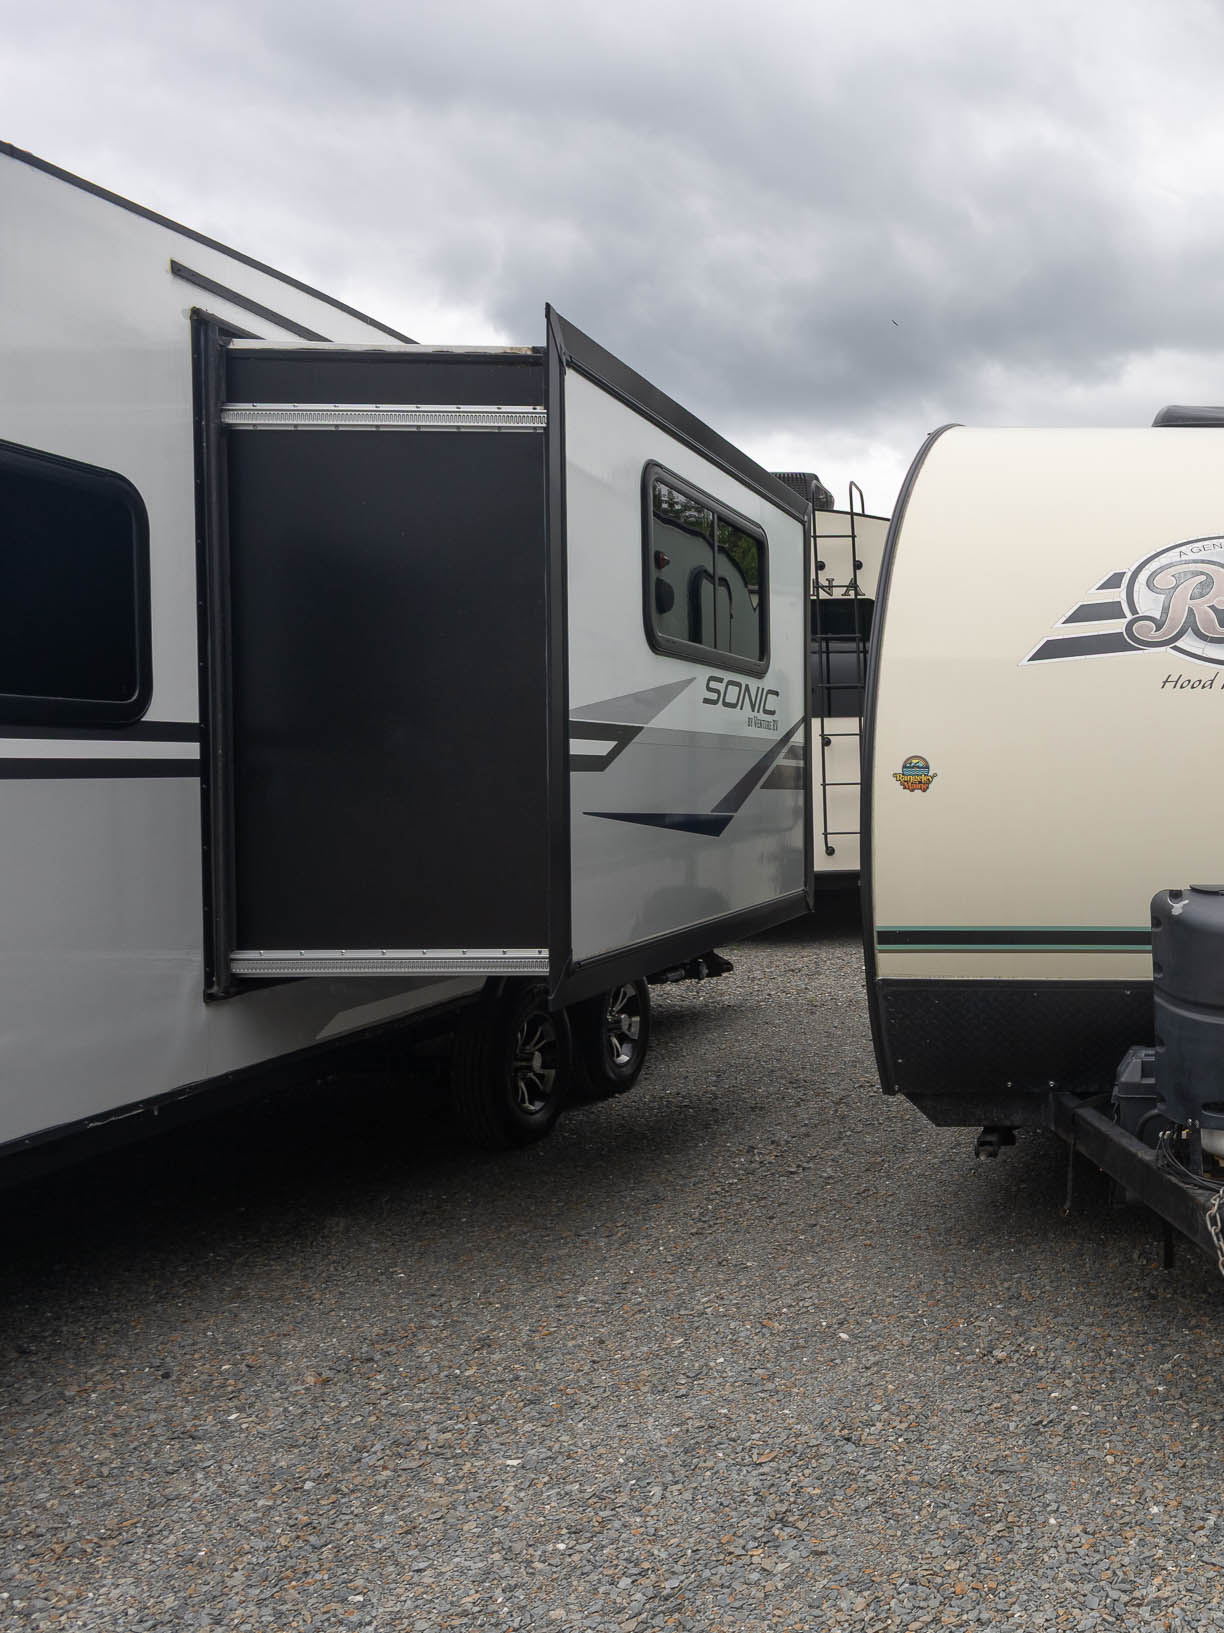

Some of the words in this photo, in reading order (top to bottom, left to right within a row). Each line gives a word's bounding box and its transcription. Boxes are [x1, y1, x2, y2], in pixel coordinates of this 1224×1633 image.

[1178, 550, 1189, 559] A
[1160, 671, 1220, 690] Hood
[702, 675, 780, 716] SONIC
